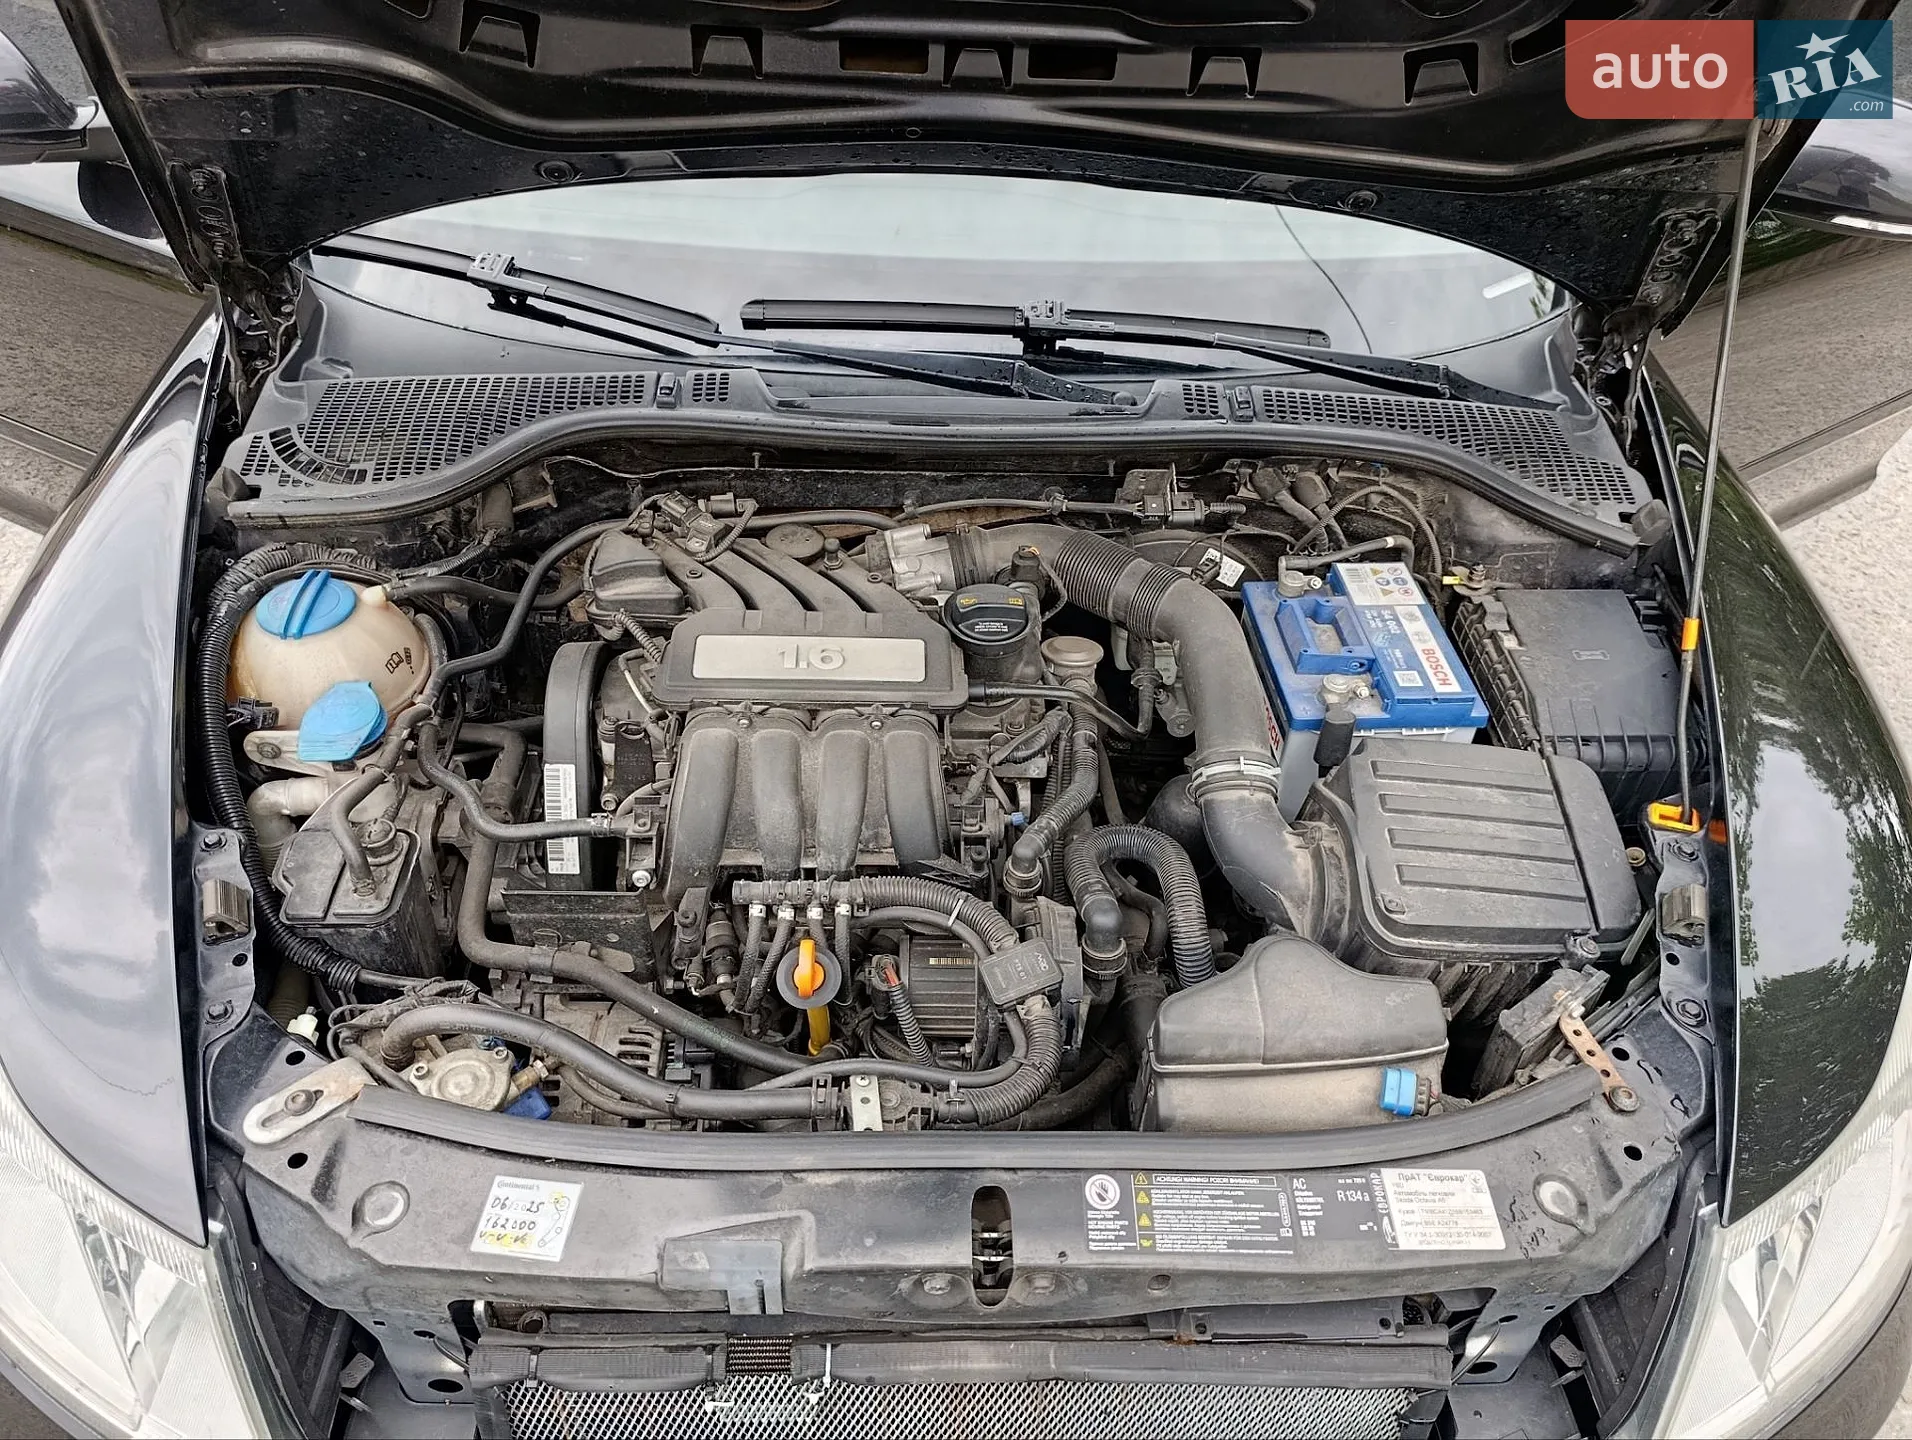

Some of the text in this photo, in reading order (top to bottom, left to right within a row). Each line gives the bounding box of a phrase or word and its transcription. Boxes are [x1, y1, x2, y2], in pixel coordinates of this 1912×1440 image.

[778, 643, 845, 670] 1.6
[1421, 648, 1452, 687] BOSCH
[1398, 1173, 1420, 1182] ПрАТ
[497, 1179, 535, 1190] Continental
[1293, 1178, 1307, 1190] AC
